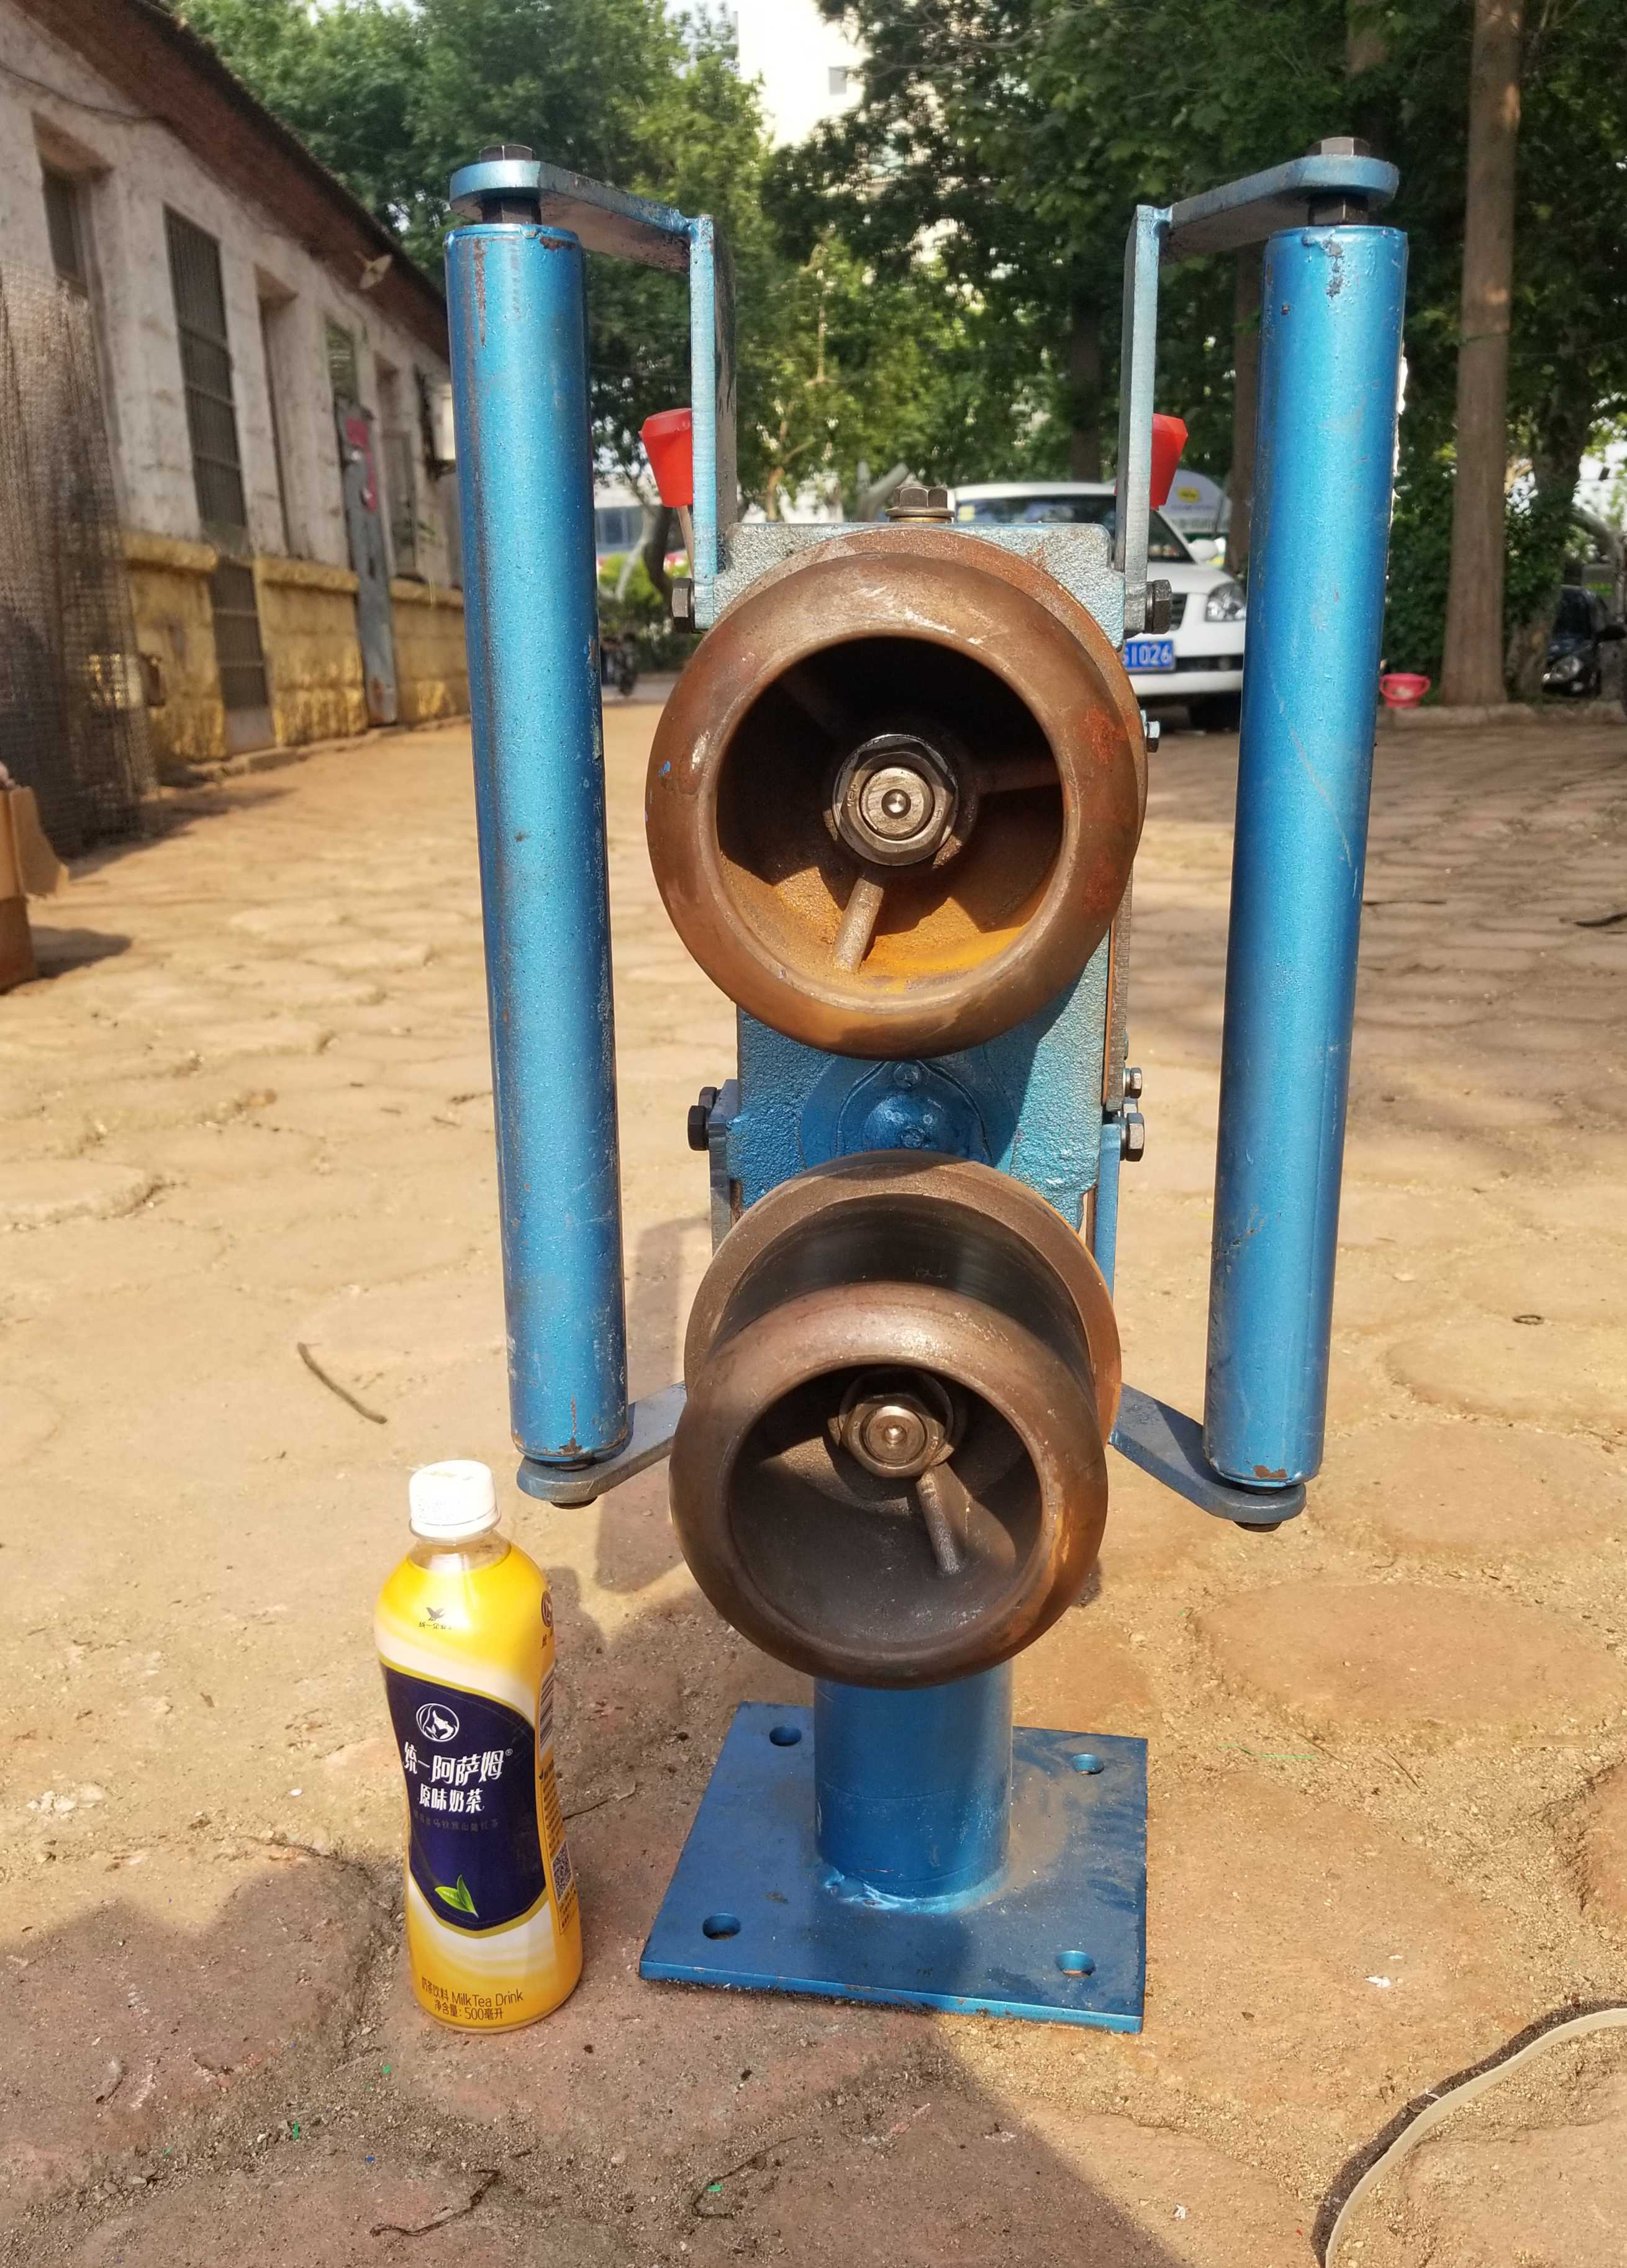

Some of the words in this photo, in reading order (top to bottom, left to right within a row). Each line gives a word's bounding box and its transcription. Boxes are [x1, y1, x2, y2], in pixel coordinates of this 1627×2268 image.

[419, 1782, 484, 1814] 原味奶茶
[422, 1976, 448, 2002] 奶茶饮料
[451, 1991, 472, 2006] Milk
[472, 1994, 492, 2007] Tea
[496, 1989, 523, 2006] Drink
